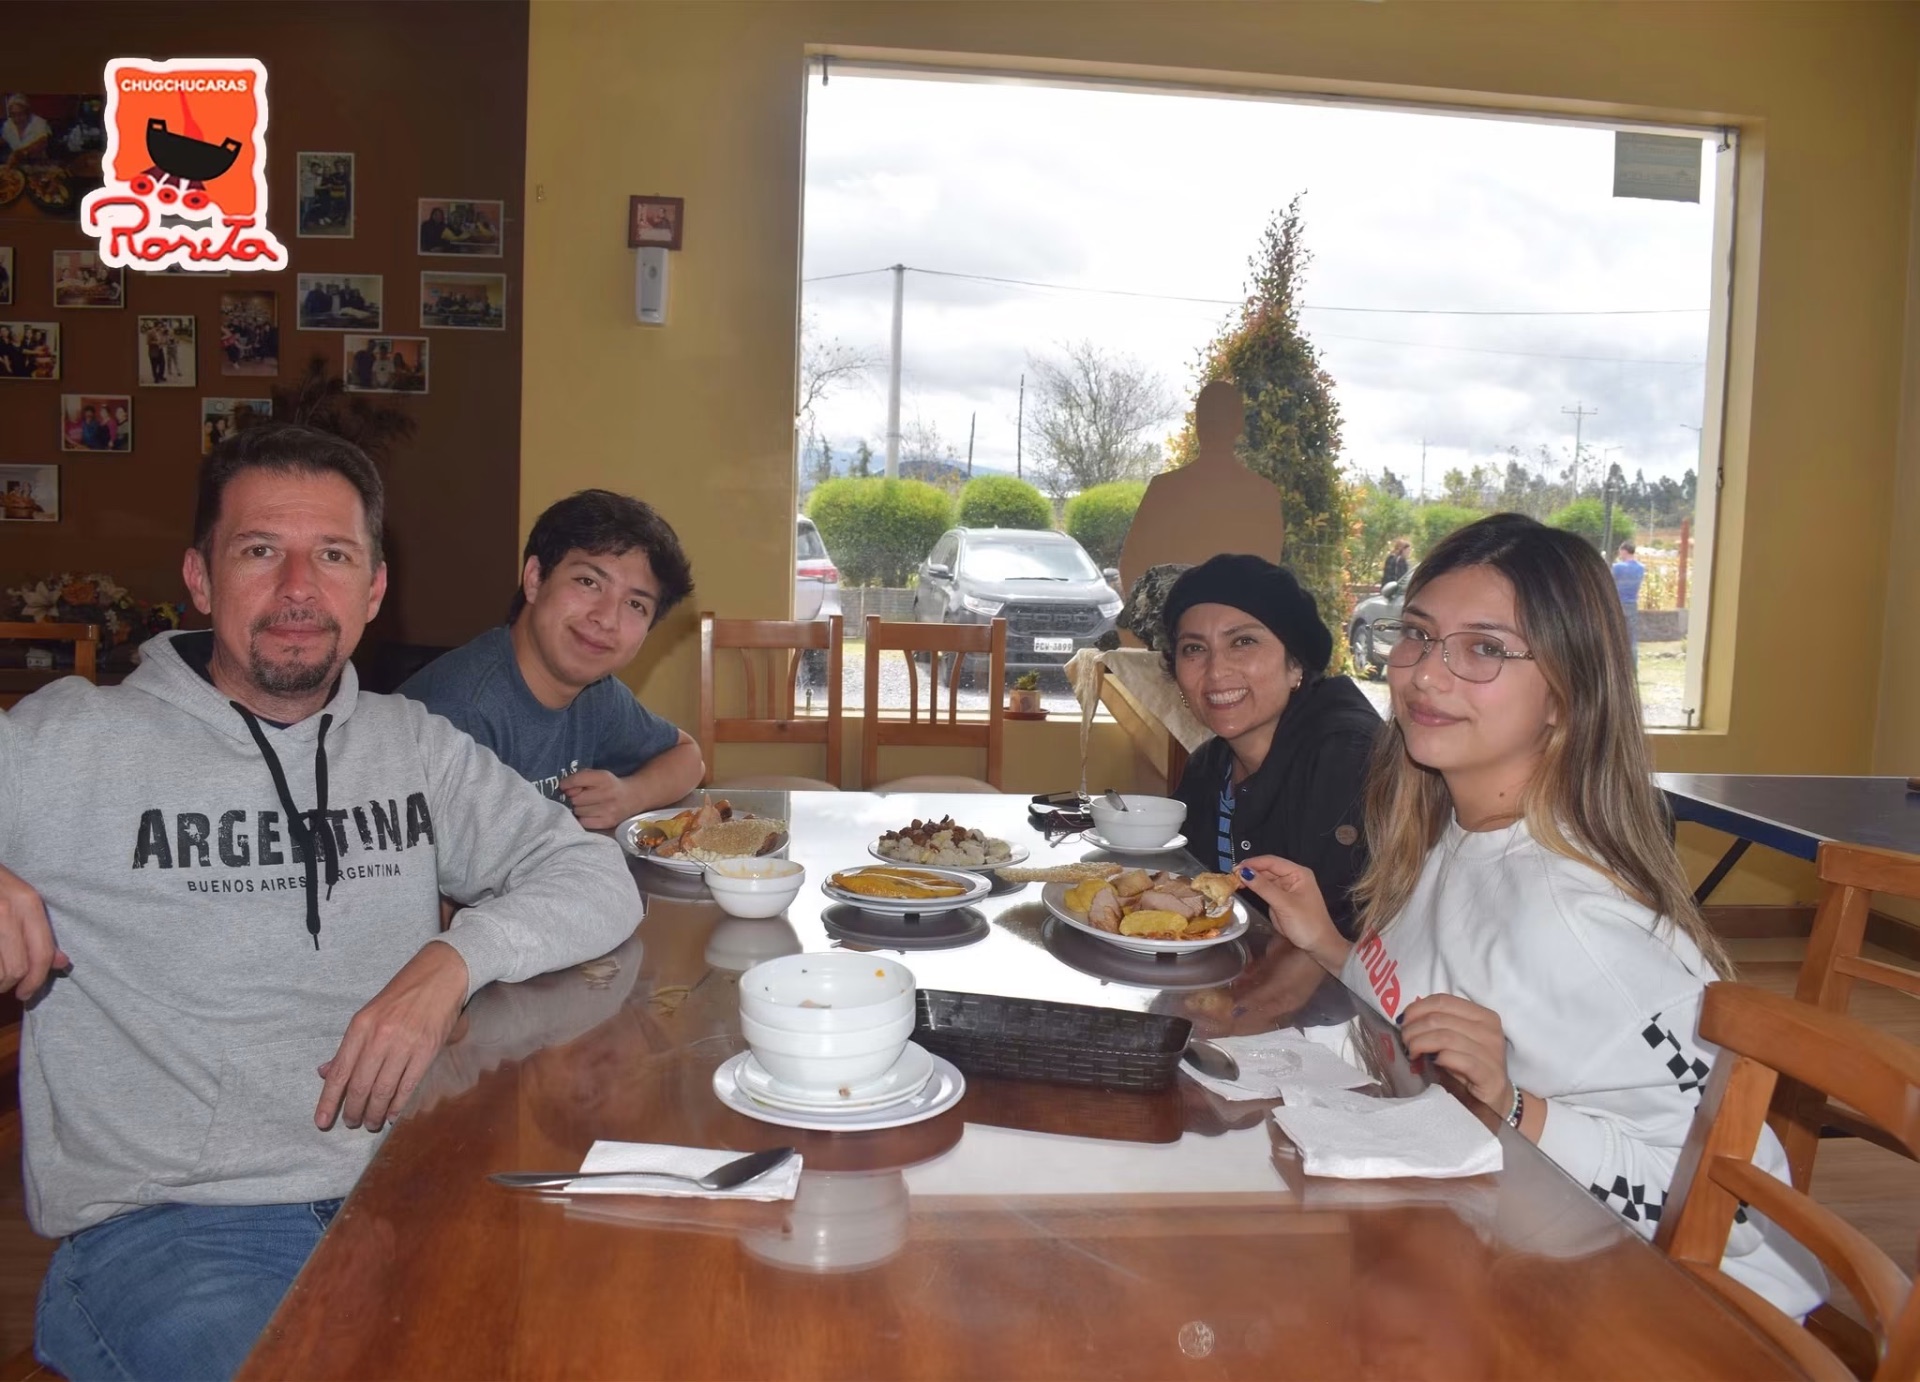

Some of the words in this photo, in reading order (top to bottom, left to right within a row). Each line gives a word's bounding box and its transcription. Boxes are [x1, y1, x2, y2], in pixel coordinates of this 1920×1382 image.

[187, 879, 254, 893] BUENOS
[260, 876, 307, 891] AIRES
[335, 863, 401, 882] RGENTINA
